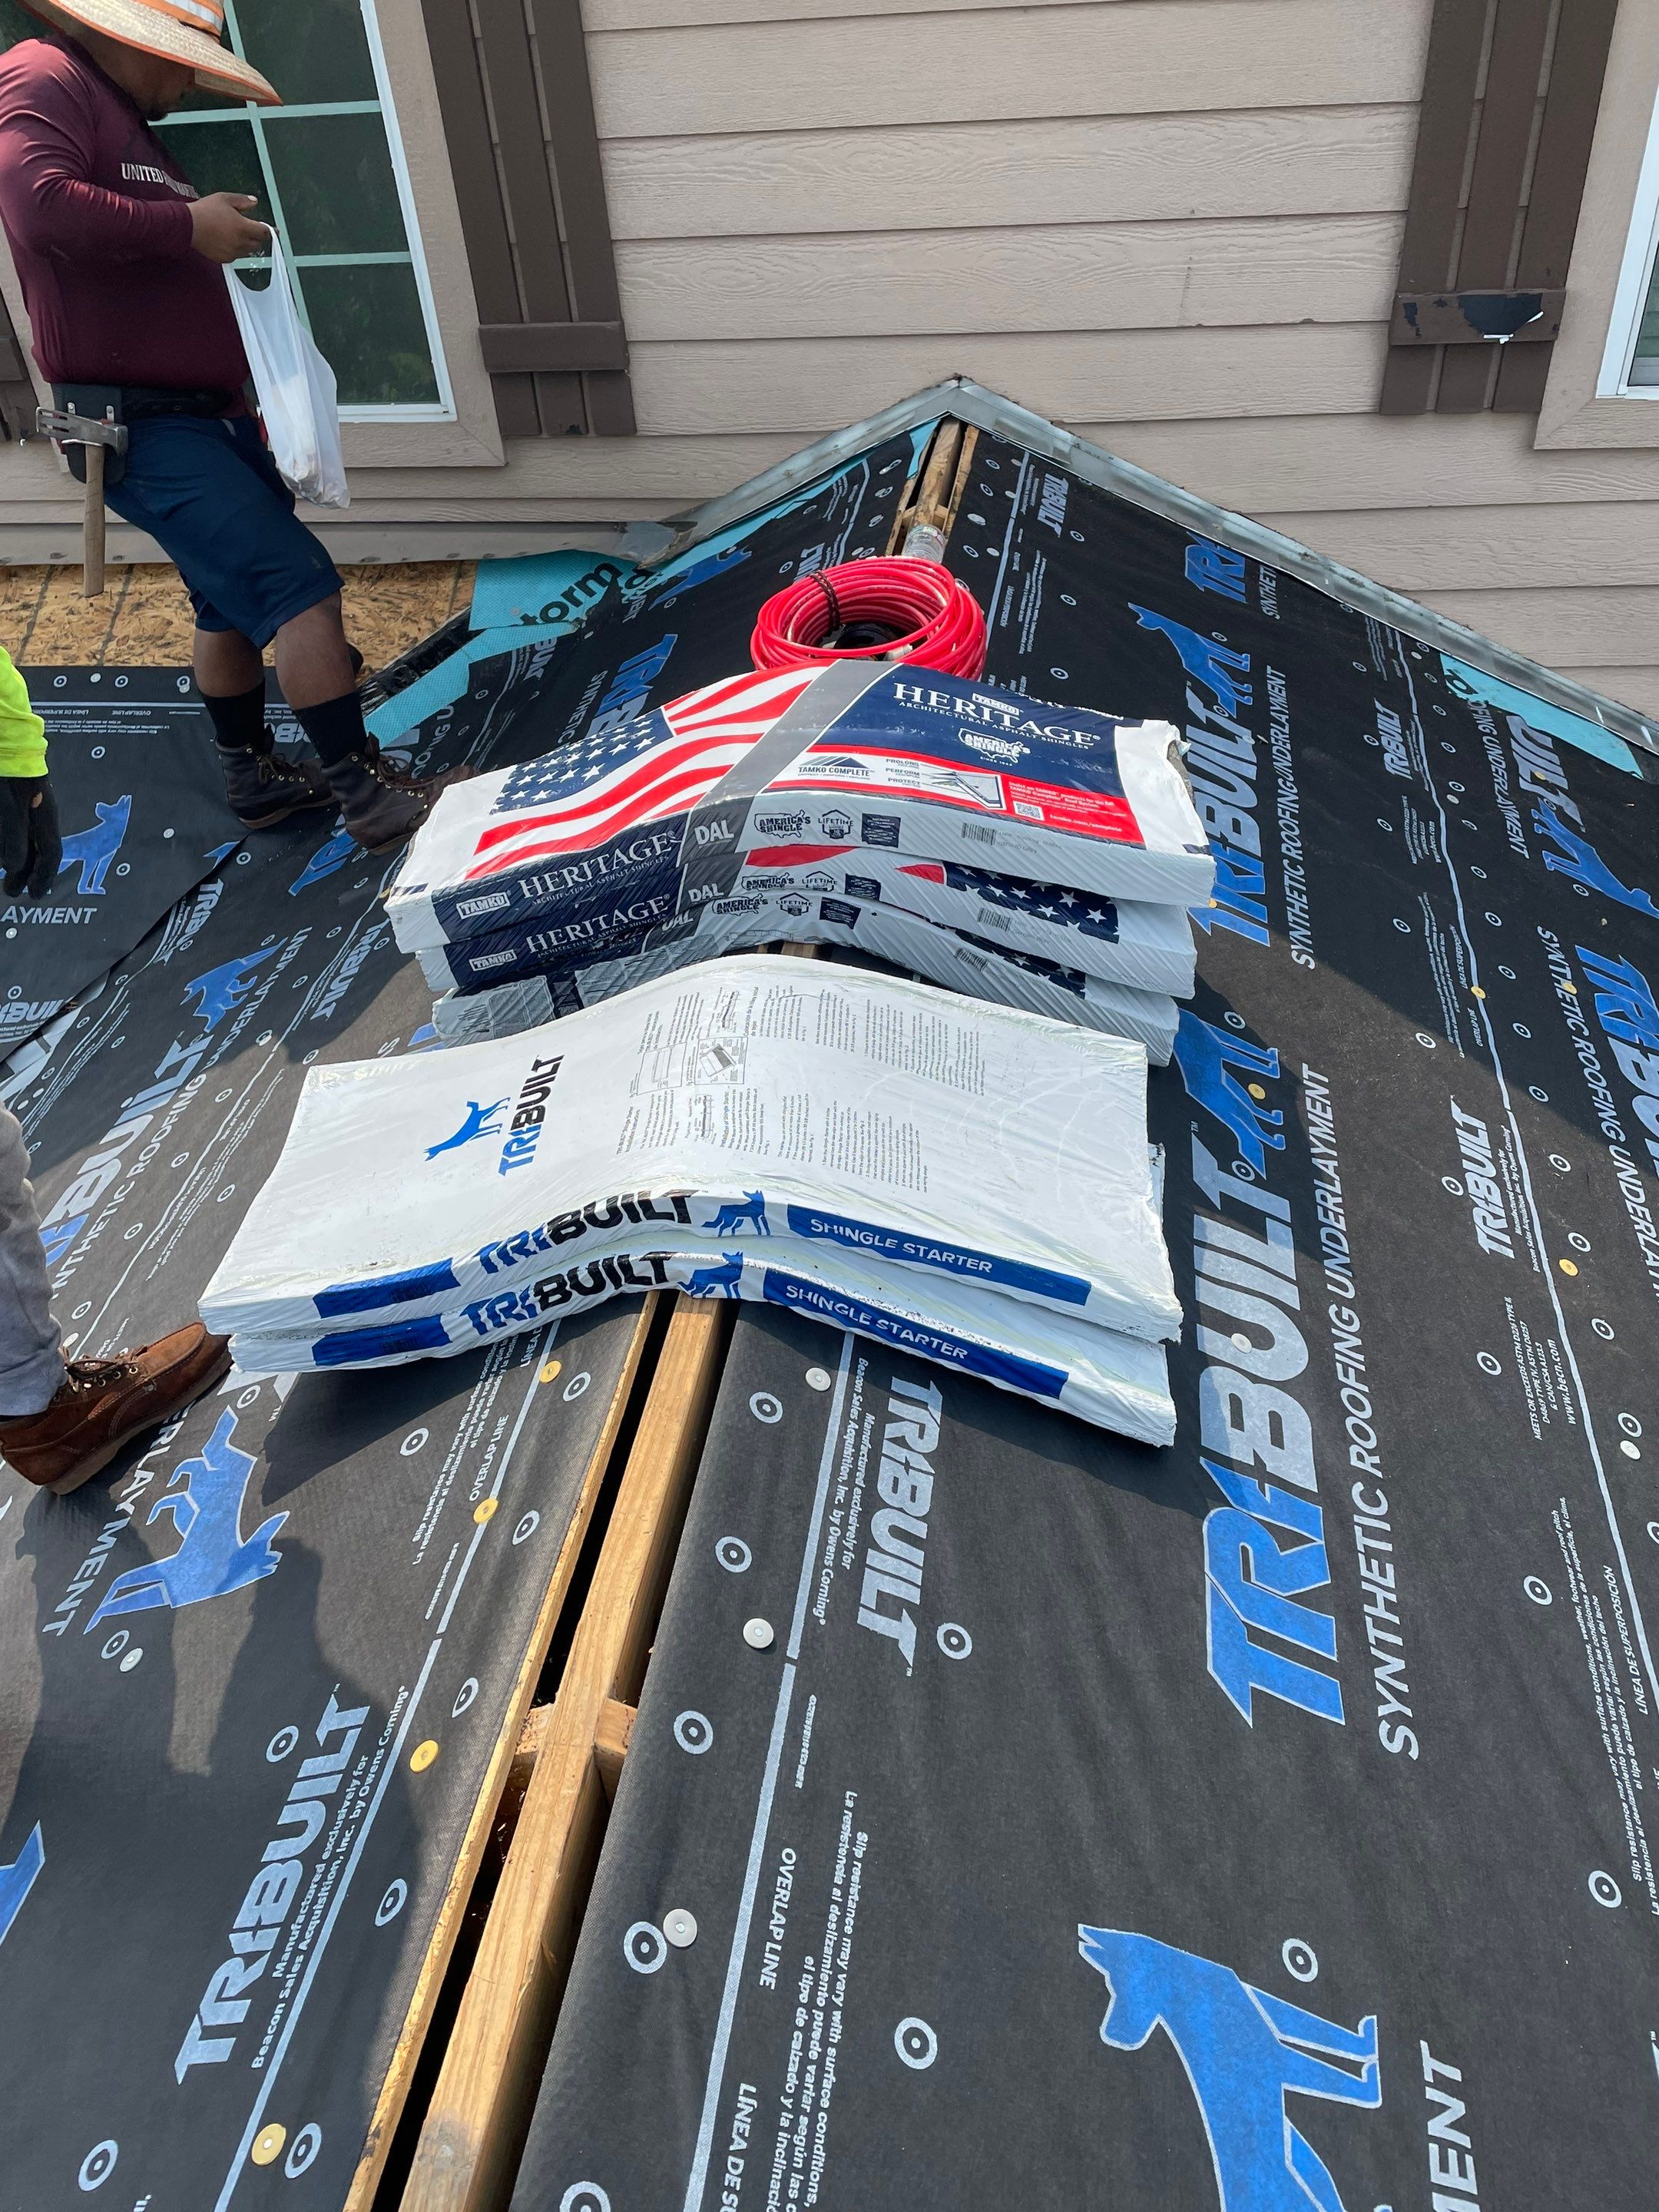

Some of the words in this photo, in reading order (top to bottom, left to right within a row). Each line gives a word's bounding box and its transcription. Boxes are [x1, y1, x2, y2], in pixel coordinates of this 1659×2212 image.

[121, 162, 164, 184] UNITED
[974, 694, 1020, 715] TAMKO
[899, 700, 988, 727] ARCHITECTURAL
[992, 722, 1038, 740] ASPHALT
[1041, 734, 1089, 750] SHINGLES
[1266, 666, 1293, 783] UNDERLAYMENT
[964, 733, 1031, 754] AMERICA'S
[965, 739, 1020, 757] SHINGLE
[829, 767, 871, 777] COMPLETE
[886, 758, 919, 767] PROLONG
[886, 768, 920, 778] PERFORM
[888, 777, 922, 786] PROTECT
[1482, 735, 1531, 859] UNDERLAYMENT
[694, 819, 734, 846] DAL
[759, 813, 810, 827] AMERICA'S
[760, 823, 803, 834] SHINGLE
[818, 817, 854, 827] LIFETIME
[688, 883, 724, 902] DAL
[802, 877, 838, 887] LIFETIME
[459, 894, 508, 916] TAMKO
[716, 898, 768, 911] AMERICA'S
[776, 899, 813, 908] LIFETIME
[1282, 859, 1316, 970] SYNTHETIC
[1537, 926, 1590, 1037] SYNTHETIC
[1572, 1035, 1626, 1143] ROOFING
[126, 1074, 207, 1179] ROOFING
[1303, 1062, 1357, 1299] UNDERLAYMENT
[810, 1219, 898, 1249] SHINGLE
[903, 1242, 993, 1273] STARTER
[786, 1285, 871, 1326] SHINGLE
[876, 1319, 969, 1359] STARTER
[1505, 1303, 1516, 1323] TYPE
[1515, 1343, 1524, 1366] ASTM
[1526, 1345, 1537, 1369] ASTM
[853, 1357, 869, 1393] Beacon
[1329, 1303, 1383, 1479] ROOFING
[1518, 1365, 1533, 1399] EXCEEDS
[1547, 1339, 1576, 1425] www.becn.com
[472, 1421, 486, 1440] tipo
[486, 1375, 504, 1408] calzado
[849, 1392, 863, 1421] Sales
[1530, 1412, 1542, 1441] MEETS
[412, 1521, 427, 1543] Slip
[422, 1473, 445, 1522] resistance
[442, 1452, 456, 1473] may
[450, 1432, 464, 1452] vary
[459, 1412, 471, 1432] with
[466, 1380, 483, 1412] surface
[469, 1442, 498, 1502] OVERLAP
[491, 1415, 510, 1443] LINE
[855, 1412, 876, 1488] Manufactured
[420, 1498, 445, 1551] resistencia
[445, 1426, 475, 1488] deslizamiento
[470, 1397, 486, 1425] puede
[842, 1487, 863, 1551] exclusively
[1551, 1509, 1564, 1532] pitch
[823, 1526, 842, 1568] Owens
[1555, 1530, 1568, 1549] roof
[1561, 1548, 1571, 1566] and
[841, 1550, 856, 1570] for
[1567, 1565, 1580, 1604] footwear
[1351, 1481, 1419, 1760] SYNTHETIC
[1583, 1595, 1600, 1647] condiciones
[1592, 1595, 1604, 1620] techo
[1603, 1565, 1636, 1658] SUPERPOSICIÓN
[1596, 1620, 1608, 1635] del
[1596, 1695, 1608, 1732] surface
[1605, 1693, 1618, 1721] variar
[1632, 1678, 1649, 1715] LÍNEA
[1611, 1724, 1627, 1756] puede
[1618, 1707, 1633, 1742] calzado
[1602, 1733, 1613, 1754] with
[1609, 1756, 1619, 1777] vary
[1630, 1759, 1641, 1780] tipo
[1615, 1778, 1626, 1801] may
[1619, 1757, 1642, 1826] deslizamiento
[833, 1810, 853, 1885] resistencia
[853, 1831, 869, 1859] Slip
[1622, 1802, 1637, 1859] resistance
[272, 1863, 326, 1979] Manufactured
[322, 1778, 362, 1860] exclusively
[353, 1755, 369, 1778] for
[1631, 1859, 1642, 1882] Slip
[1640, 1839, 1657, 1903] resistencia
[251, 2002, 286, 2069] Beacon
[279, 1954, 305, 1999] Sales
[349, 1800, 367, 1820] by
[359, 1748, 386, 1797] Owens
[770, 1847, 796, 1941] OVERLAP
[843, 1860, 862, 1935] resistance
[759, 1941, 782, 1990] LINE
[816, 1904, 842, 2007] deslizamiento
[836, 1937, 852, 1971] may
[798, 1973, 814, 2004] tipo
[832, 1973, 847, 2007] vary
[809, 2008, 825, 2061] puede
[829, 2010, 843, 2044] with
[785, 2031, 803, 2094] calzado
[820, 2046, 837, 2109] surface
[800, 2065, 817, 2113] variar
[729, 2082, 759, 2151] LÍNEA
[792, 2114, 810, 2169] según
[724, 2155, 745, 2191] DE
[803, 2111, 828, 2208] conditions,
[788, 2172, 804, 2200] las
